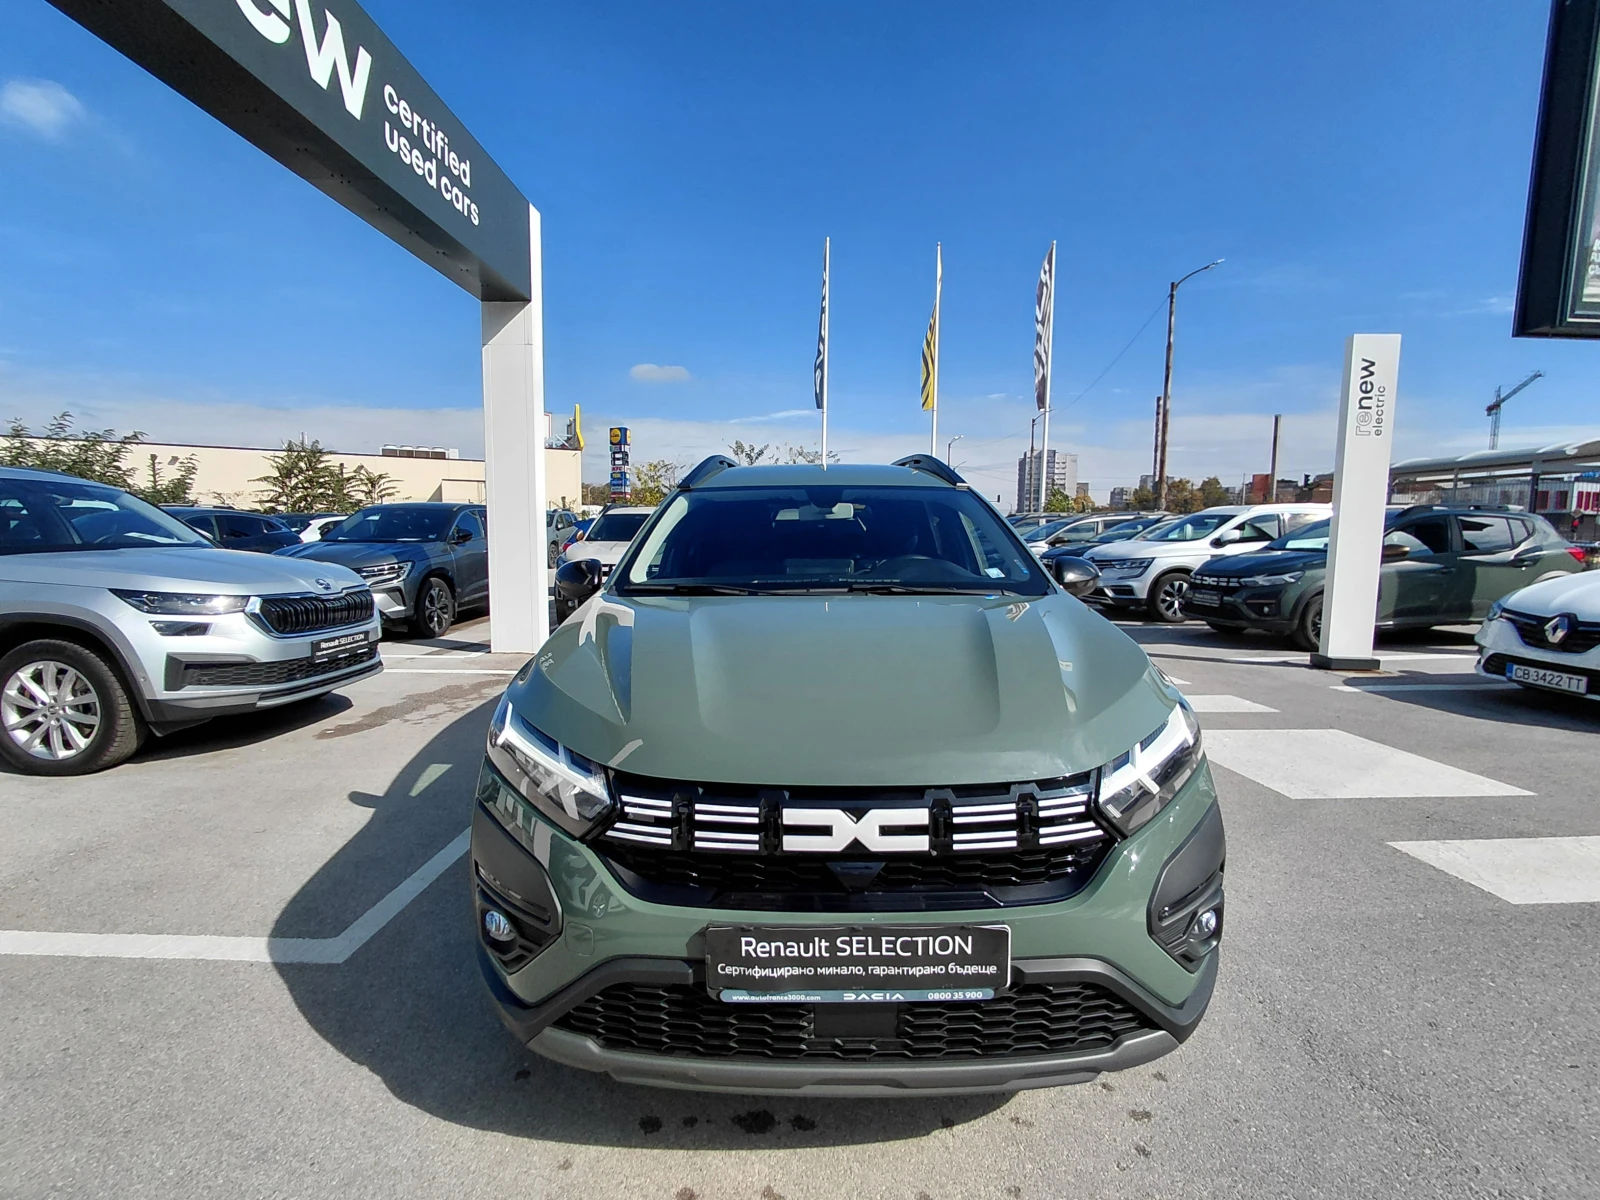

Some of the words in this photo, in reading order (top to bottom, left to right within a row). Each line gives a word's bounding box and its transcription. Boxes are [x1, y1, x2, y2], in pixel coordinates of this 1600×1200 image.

[383, 84, 471, 188] certified
[384, 120, 437, 189] used
[440, 175, 480, 226] cars
[1355, 357, 1376, 436] renew
[1372, 385, 1386, 436] electric
[1532, 670, 1563, 687] 3422
[1566, 676, 1584, 691] TT
[740, 936, 830, 957] Renault
[836, 935, 973, 957] SELECTION
[717, 963, 814, 979] Сертифицирано
[817, 965, 866, 976] минало,
[868, 964, 946, 978] гарантирано
[947, 962, 998, 975] бъдеще
[927, 992, 952, 1001] 0800
[953, 991, 965, 1000] 35
[965, 991, 984, 1000] 900
